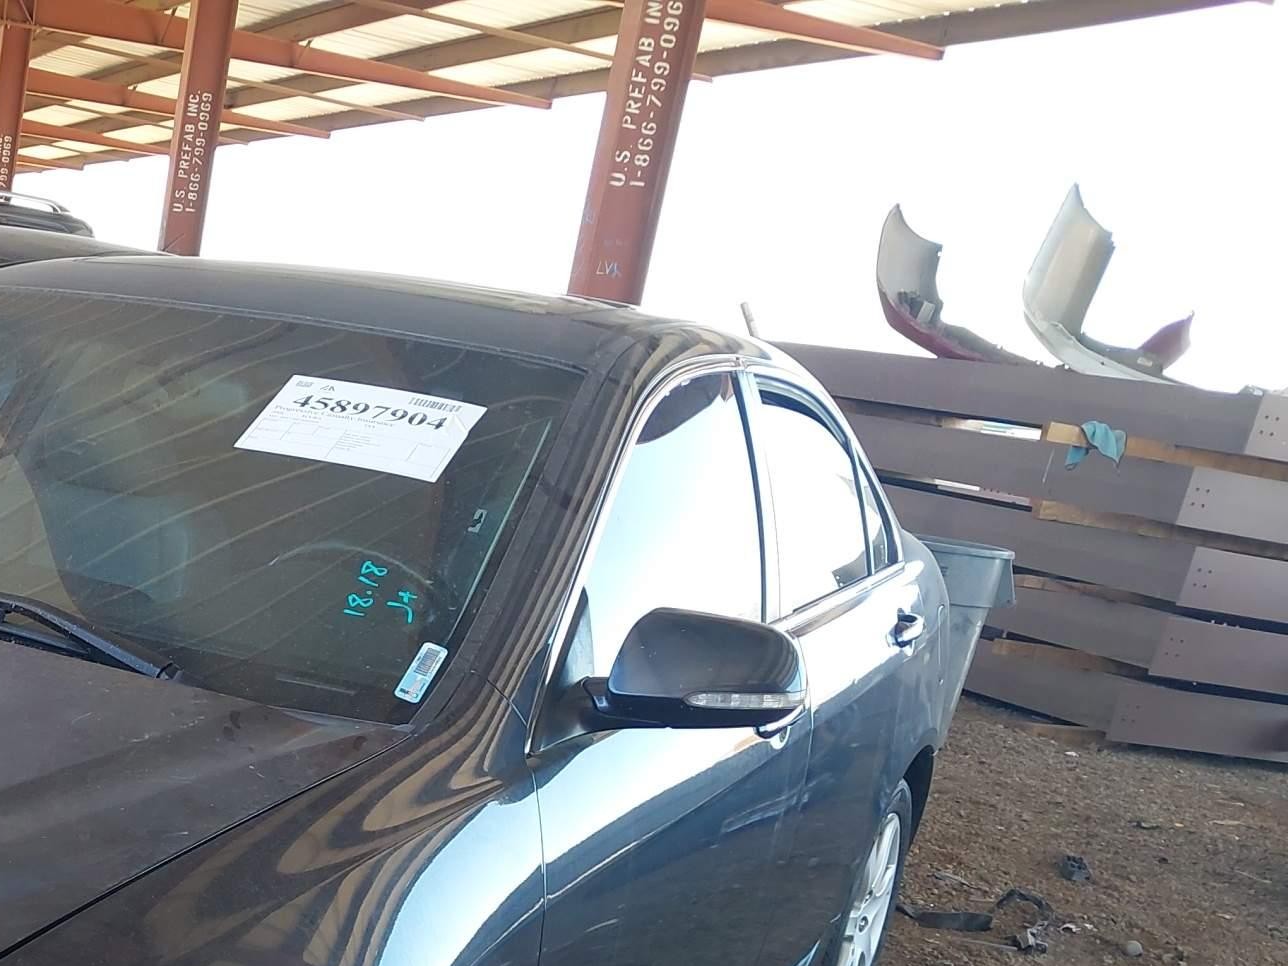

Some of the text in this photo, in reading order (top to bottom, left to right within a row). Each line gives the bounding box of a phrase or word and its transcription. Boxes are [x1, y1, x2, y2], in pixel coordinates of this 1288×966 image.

[186, 90, 201, 117] INC.
[609, 144, 633, 187] U.S.
[622, 37, 655, 130] PREFAB
[178, 124, 195, 178] PREFAB
[185, 92, 213, 213] 1-866-799-0969
[293, 394, 448, 430] 45897904
